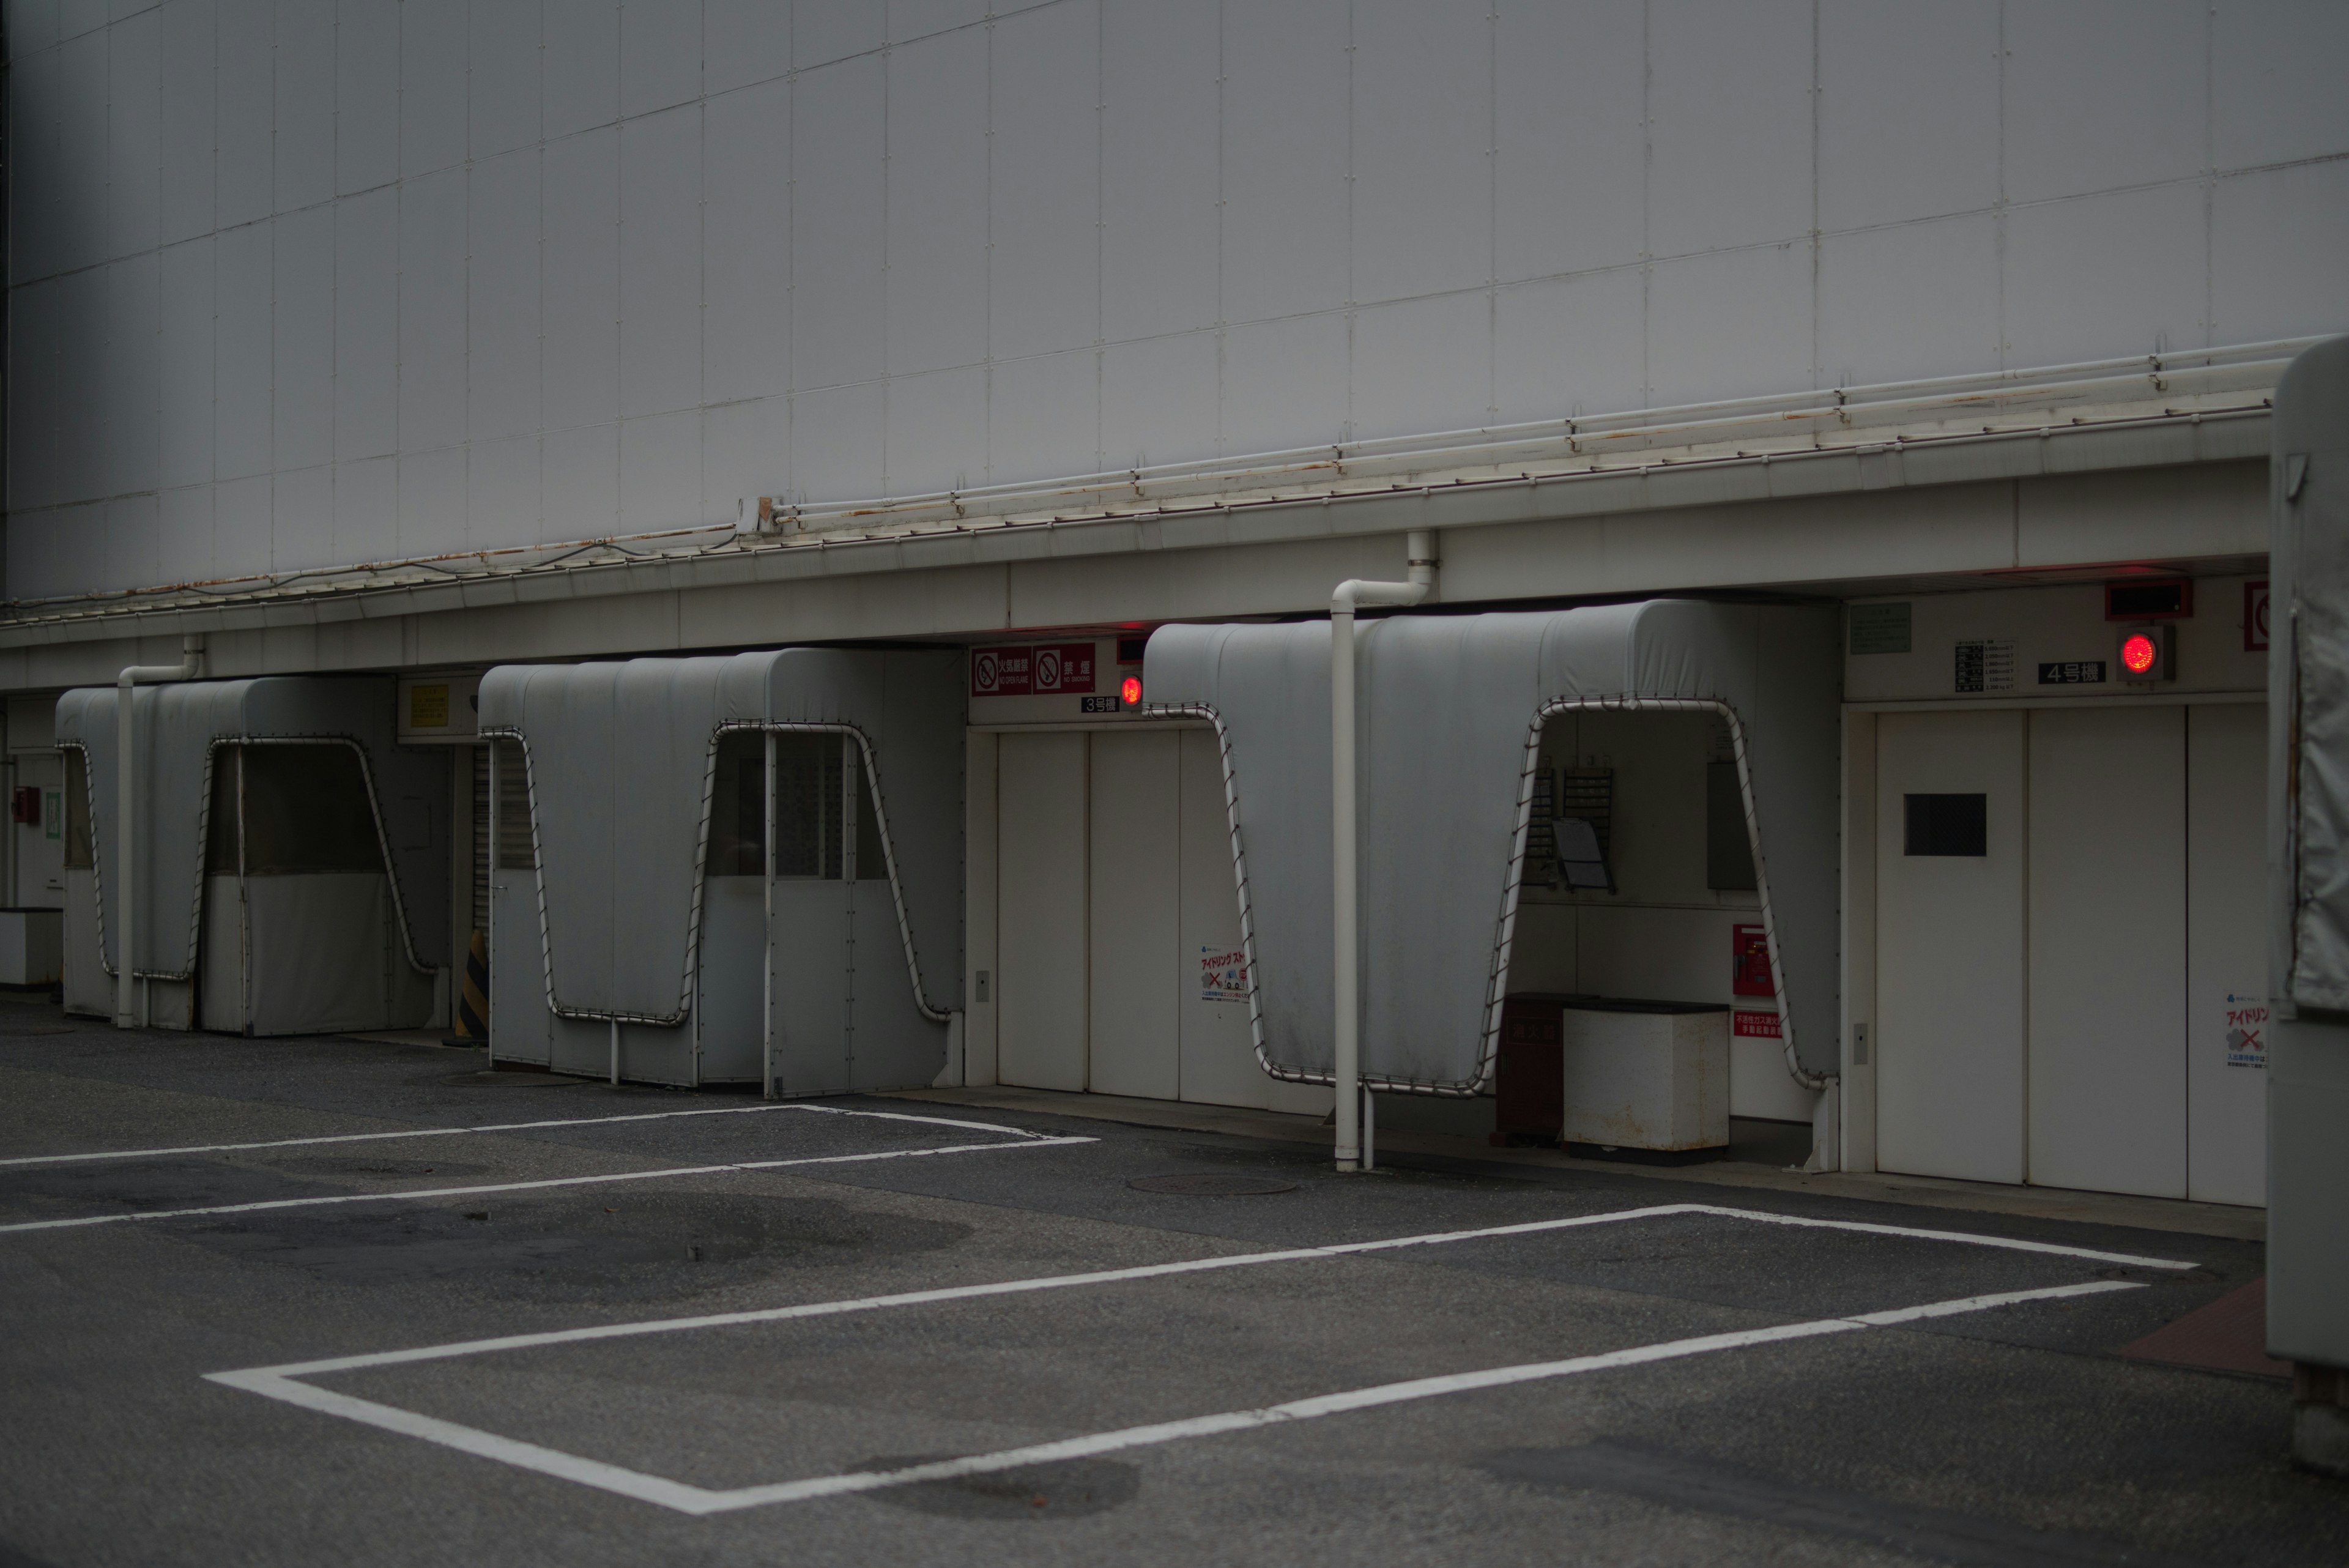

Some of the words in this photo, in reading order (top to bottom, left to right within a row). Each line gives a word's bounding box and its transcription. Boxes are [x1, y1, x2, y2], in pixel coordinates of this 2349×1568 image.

[999, 659, 1028, 673] 火気厳禁
[1064, 661, 1090, 675] 禁煙
[2047, 663, 2099, 682] 4号機
[1006, 676, 1015, 685] OPEN
[1016, 675, 1028, 684] FLAME
[1086, 697, 1116, 712] 3号機
[1201, 953, 1231, 970] アイドリング
[1513, 1023, 1555, 1040] 消火器
